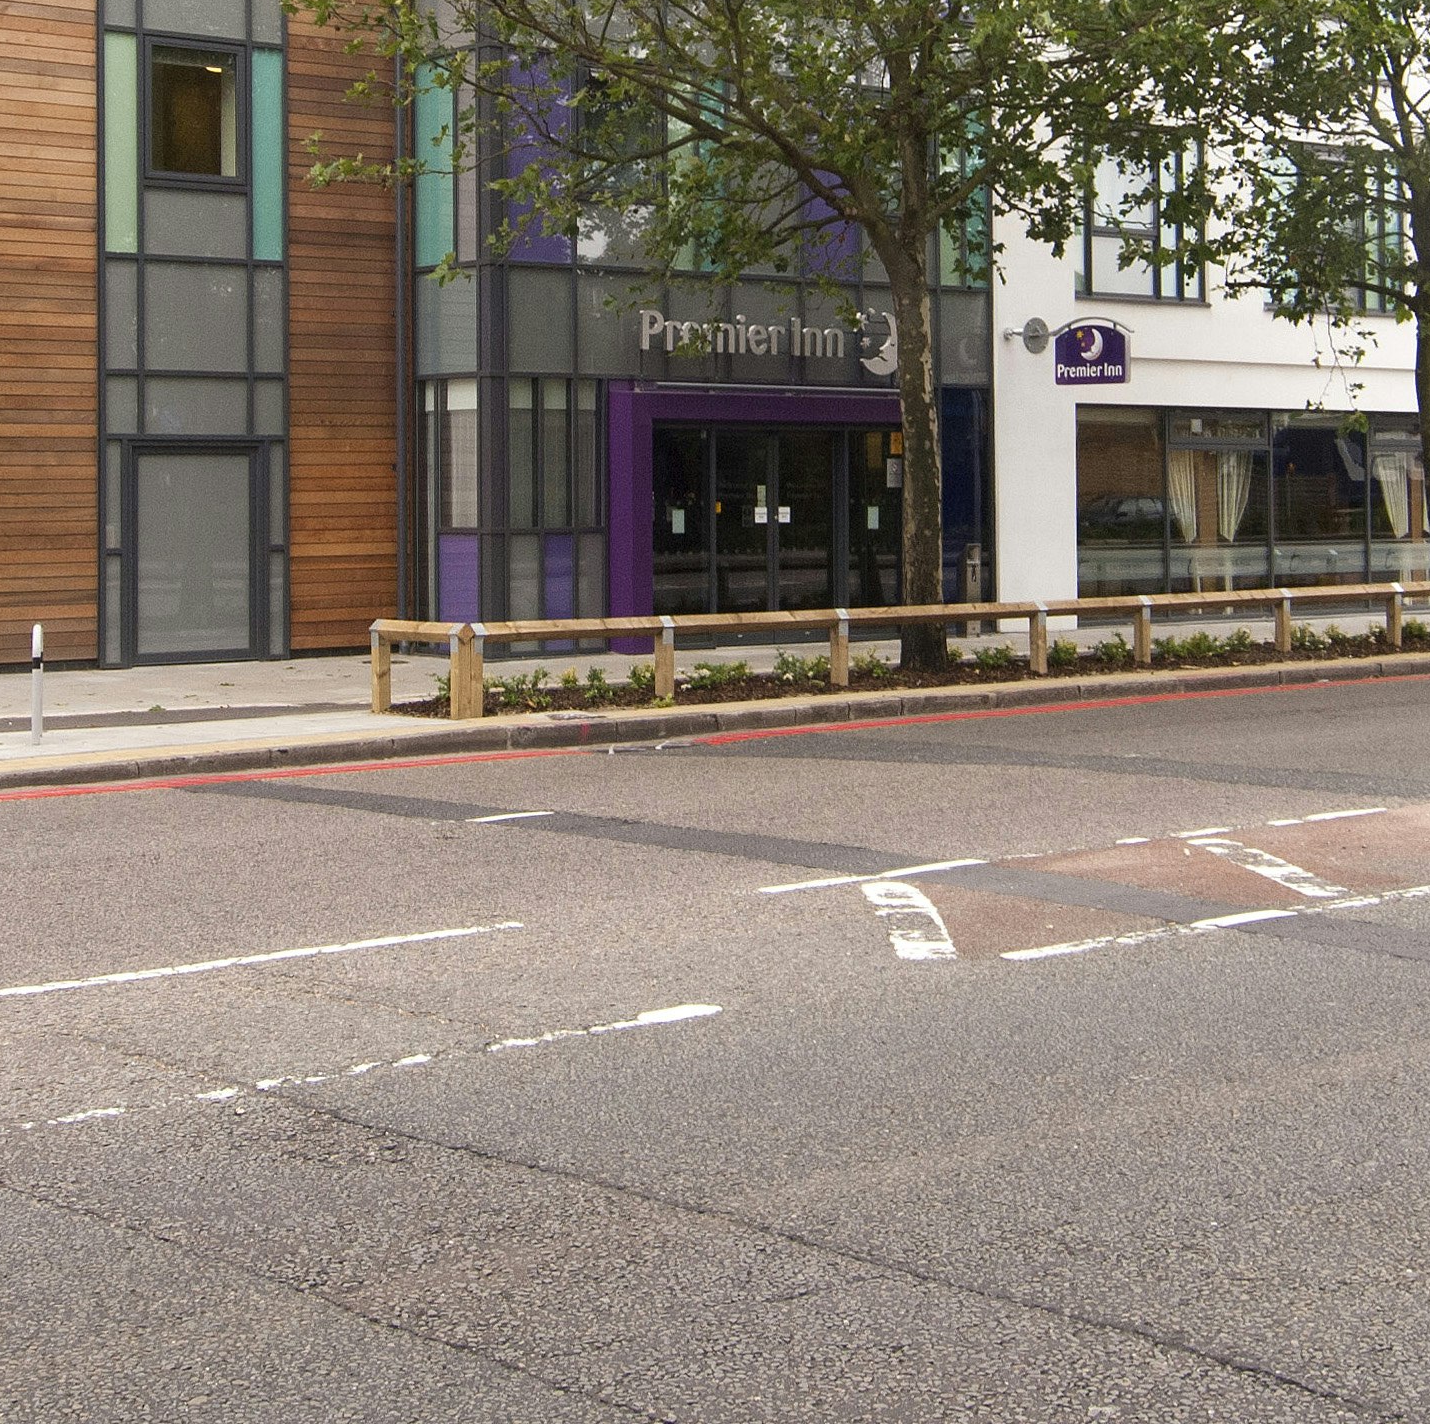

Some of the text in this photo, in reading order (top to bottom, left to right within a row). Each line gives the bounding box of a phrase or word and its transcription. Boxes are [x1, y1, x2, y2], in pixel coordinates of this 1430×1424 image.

[790, 317, 845, 358] Inn
[1057, 362, 1123, 378] Premier Inn
